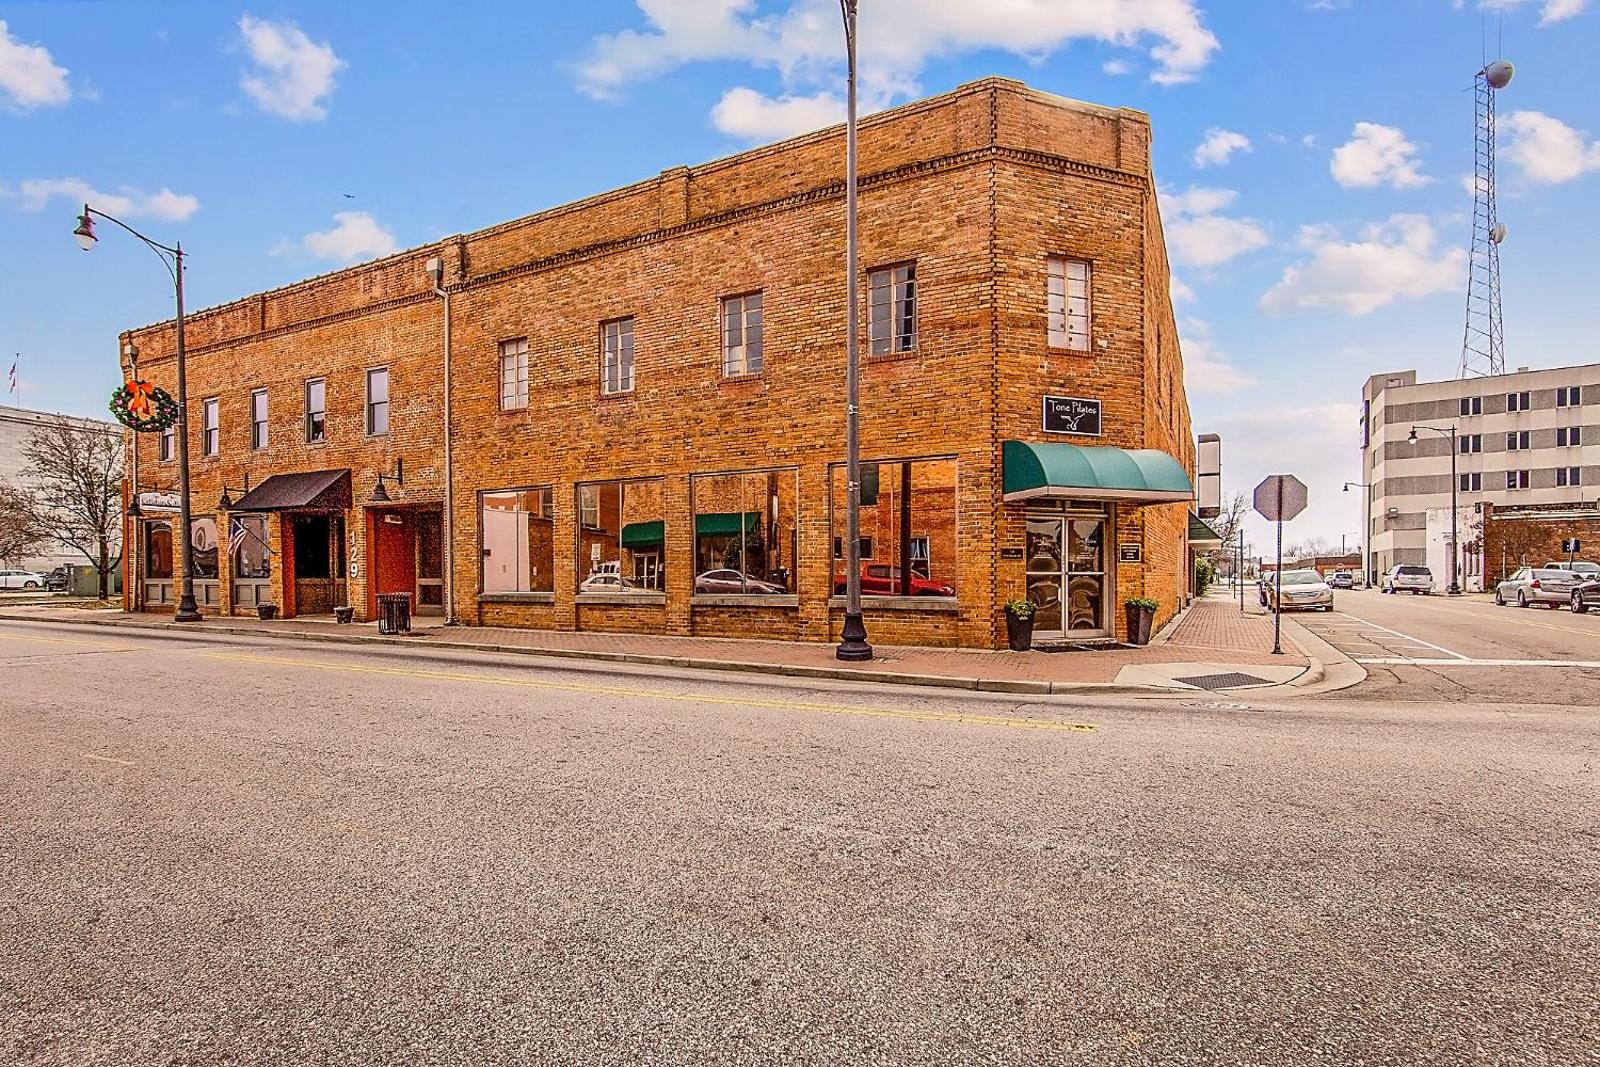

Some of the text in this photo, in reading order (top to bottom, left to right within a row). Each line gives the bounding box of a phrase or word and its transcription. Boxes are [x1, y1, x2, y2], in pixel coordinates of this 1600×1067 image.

[1048, 400, 1097, 414] Tone Pilates
[350, 531, 358, 577] 129
